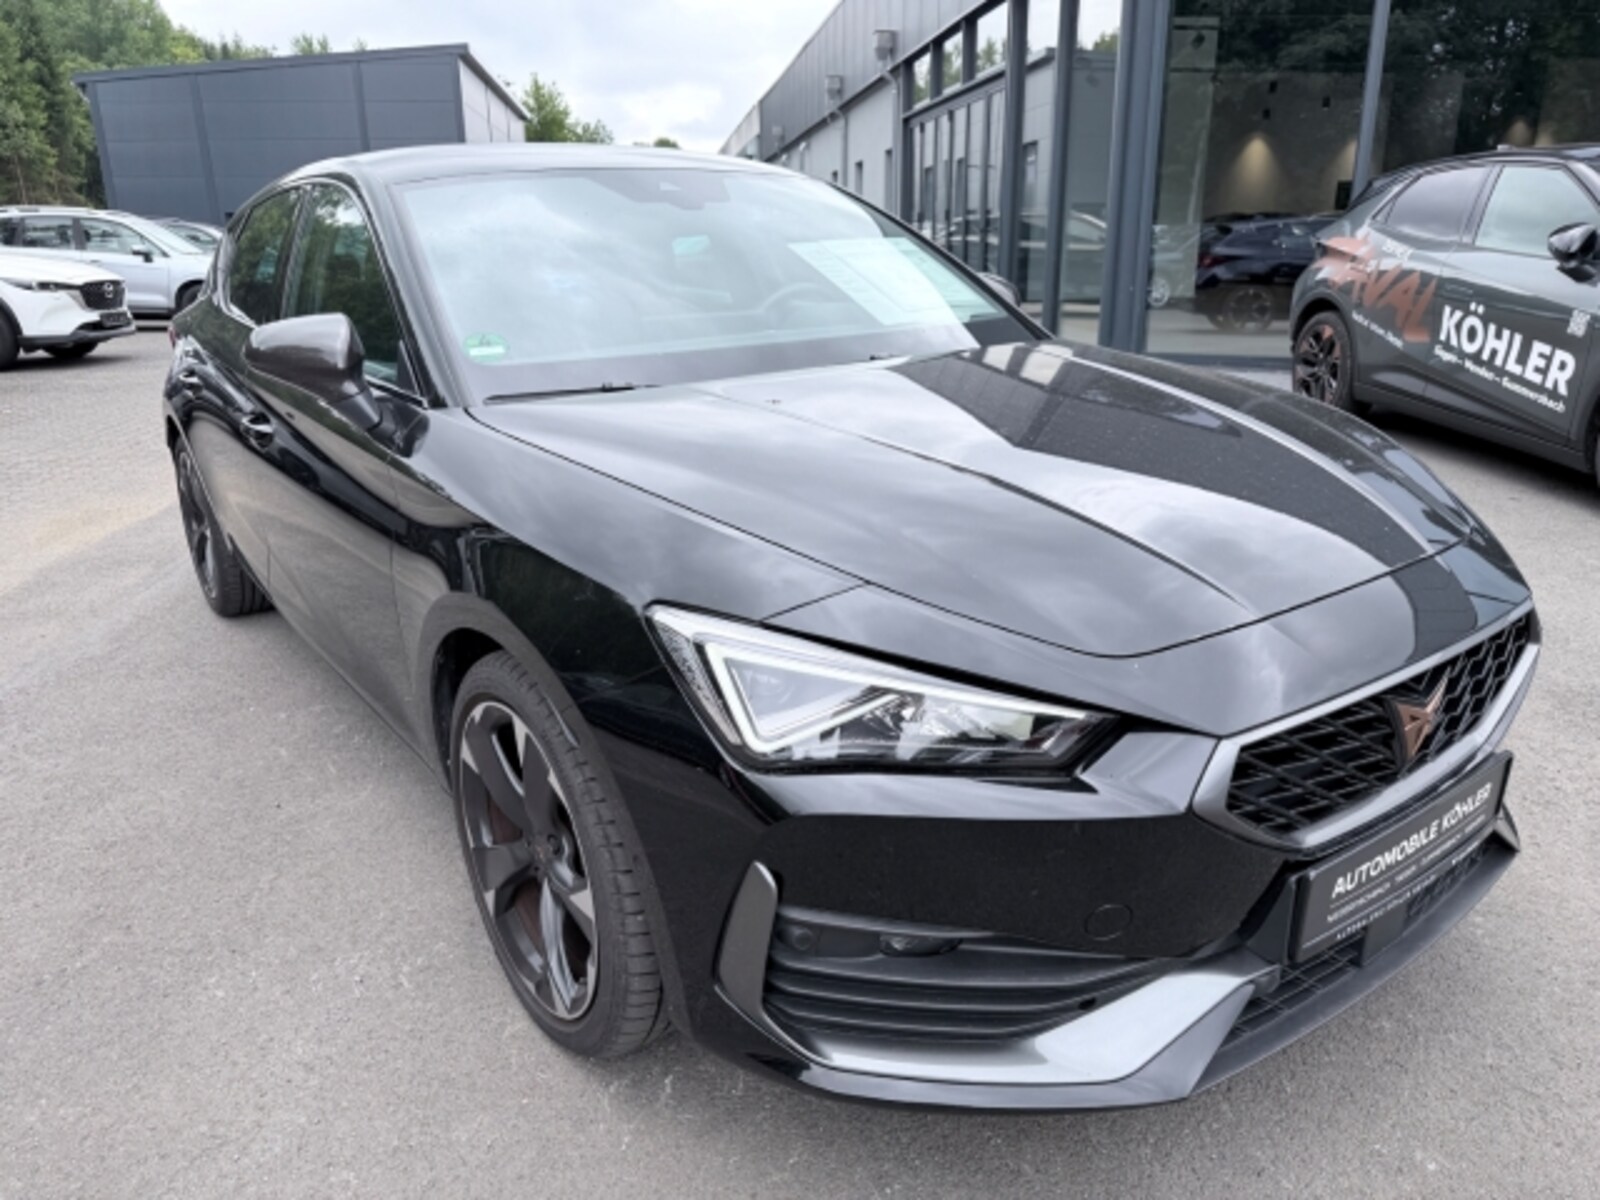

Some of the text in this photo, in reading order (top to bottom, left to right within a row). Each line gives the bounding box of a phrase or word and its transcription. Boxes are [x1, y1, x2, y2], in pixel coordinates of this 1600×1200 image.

[1439, 302, 1576, 397] KÖHLER
[1332, 819, 1440, 898] AUTOMOBILE
[1442, 782, 1492, 832] KÖHLER
